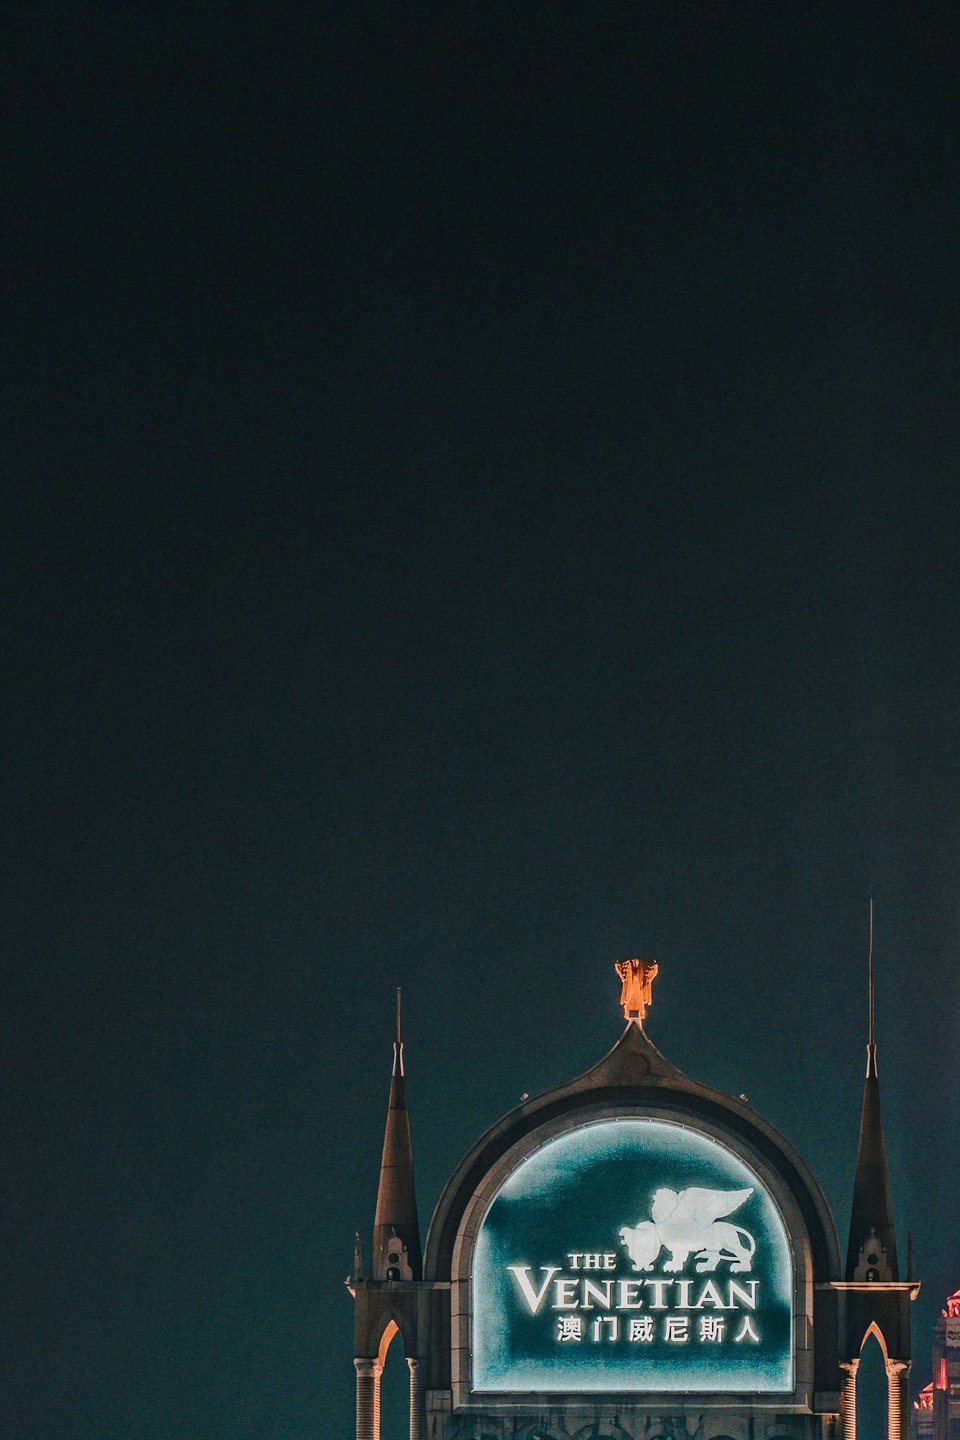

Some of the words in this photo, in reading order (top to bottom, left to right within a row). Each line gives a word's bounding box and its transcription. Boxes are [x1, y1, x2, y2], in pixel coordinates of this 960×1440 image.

[568, 1254, 616, 1269] THE
[507, 1266, 760, 1314] VENETIAN
[557, 1316, 760, 1342] 澳门威尼斯人
